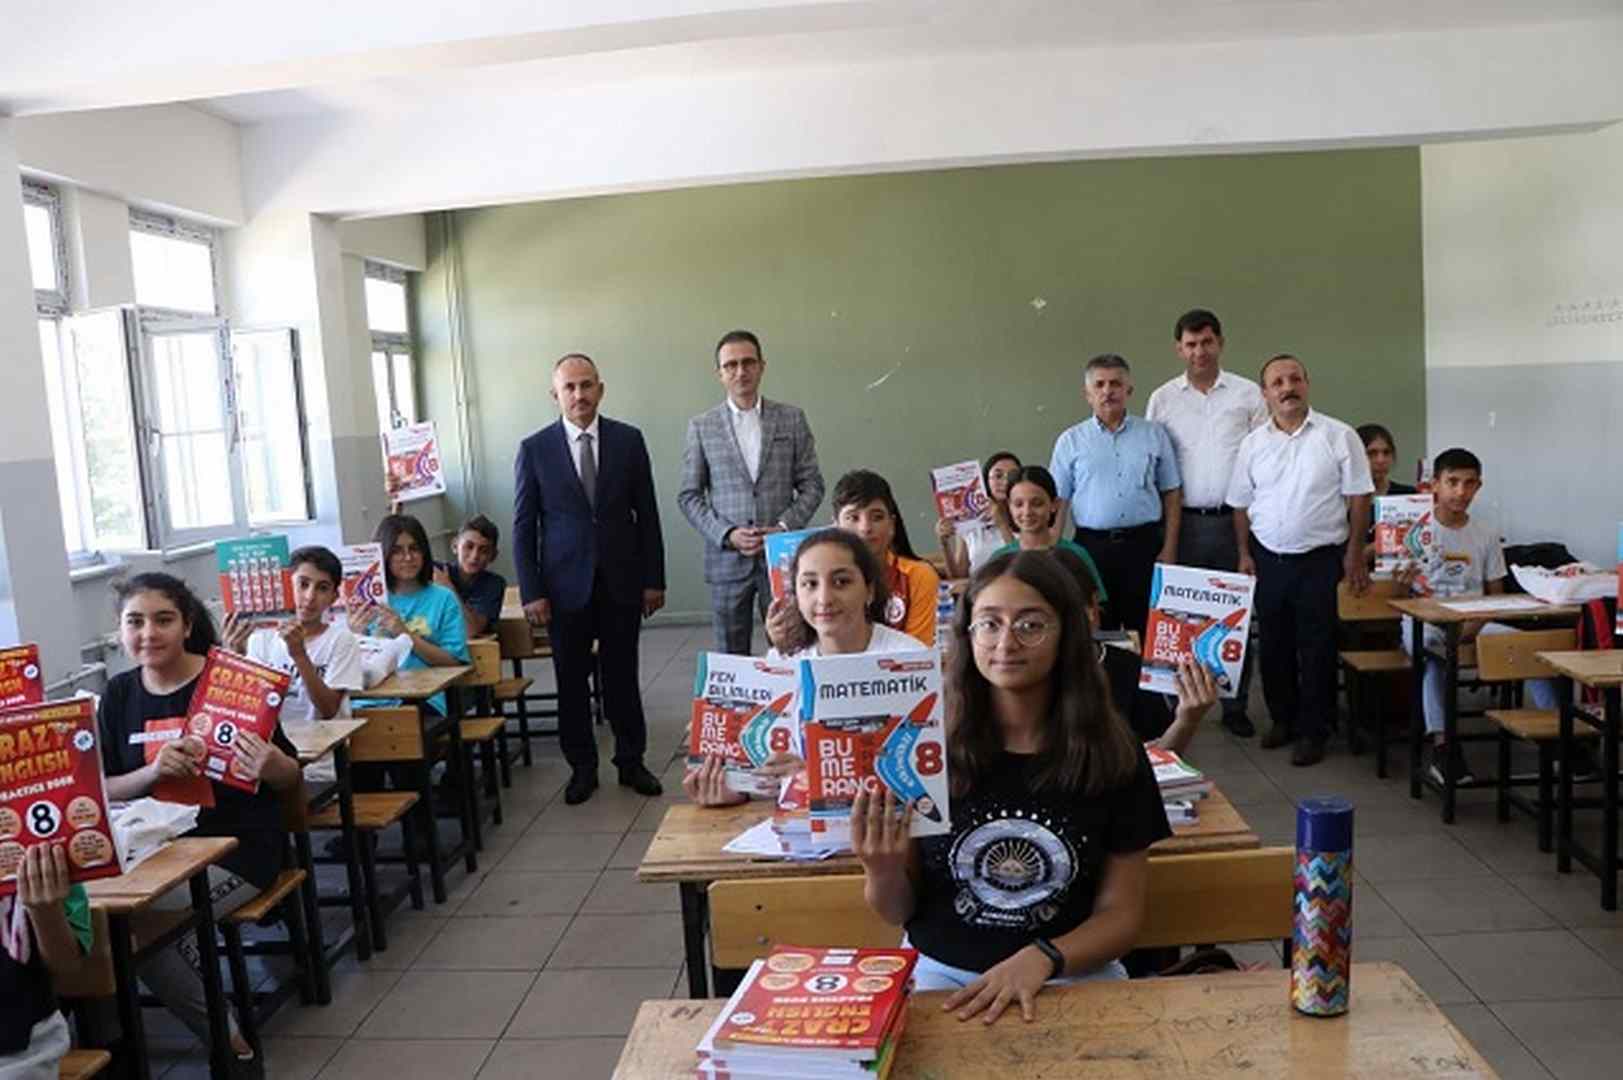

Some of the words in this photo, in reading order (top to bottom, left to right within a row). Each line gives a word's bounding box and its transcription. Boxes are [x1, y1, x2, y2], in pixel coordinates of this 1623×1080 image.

[1221, 638, 1244, 663] 8
[819, 675, 927, 700] MATEMATİK
[703, 712, 727, 727] BU
[0, 721, 66, 761] RAZY
[218, 722, 233, 744] 8
[702, 727, 727, 741] ME
[770, 727, 791, 752] 8
[818, 738, 853, 759] BU
[915, 741, 944, 777] 8
[0, 749, 71, 784] NGLISH
[821, 757, 857, 777] ME
[822, 776, 879, 797] RANG
[31, 803, 55, 834] 8
[814, 975, 841, 991] 8
